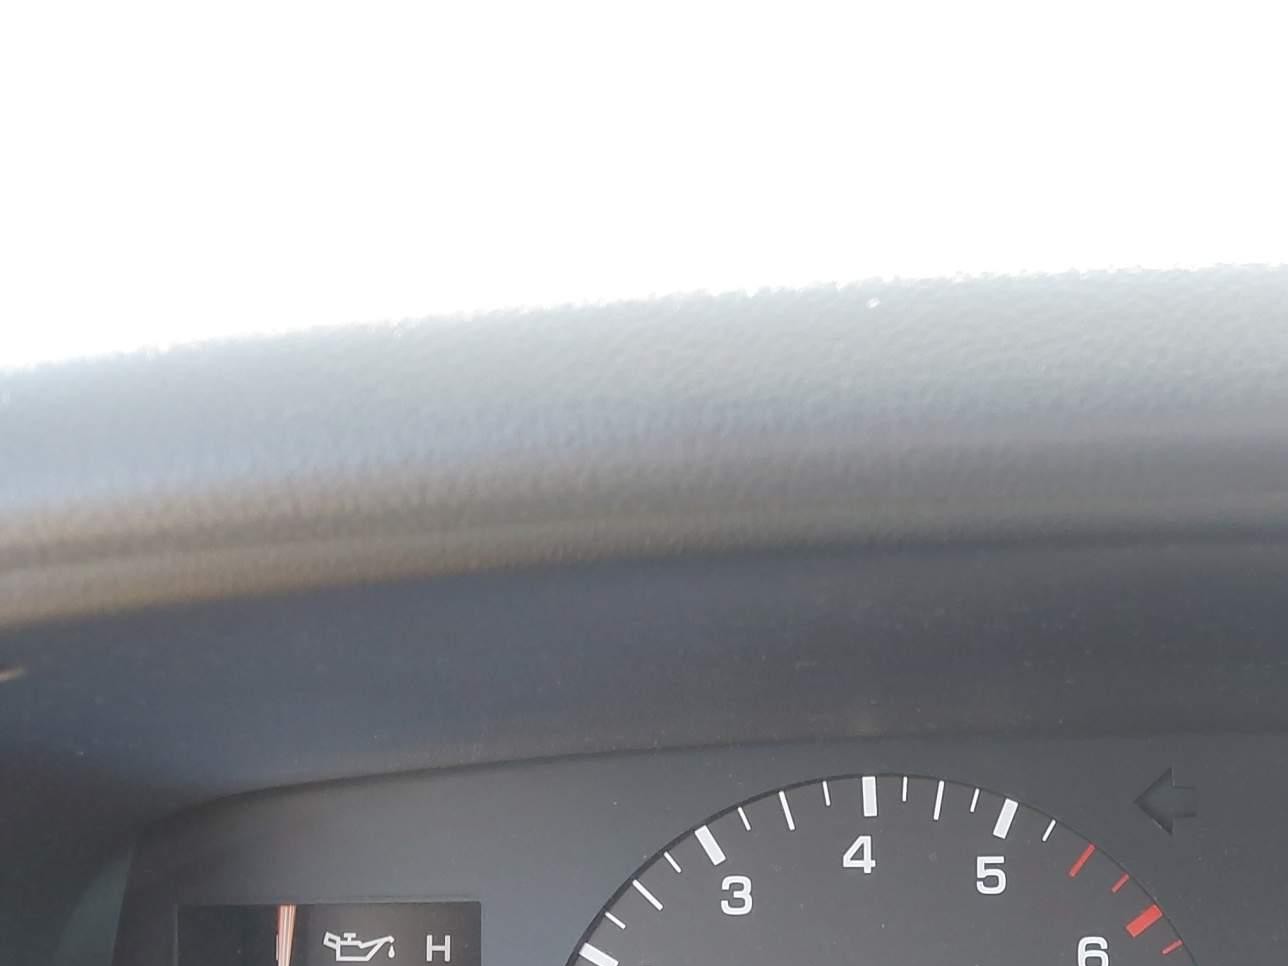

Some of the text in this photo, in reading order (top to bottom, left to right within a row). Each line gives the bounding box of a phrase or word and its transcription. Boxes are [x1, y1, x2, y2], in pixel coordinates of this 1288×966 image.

[842, 835, 876, 874] 4
[976, 855, 1007, 895] 5
[720, 875, 753, 916] 3
[426, 934, 451, 962] H
